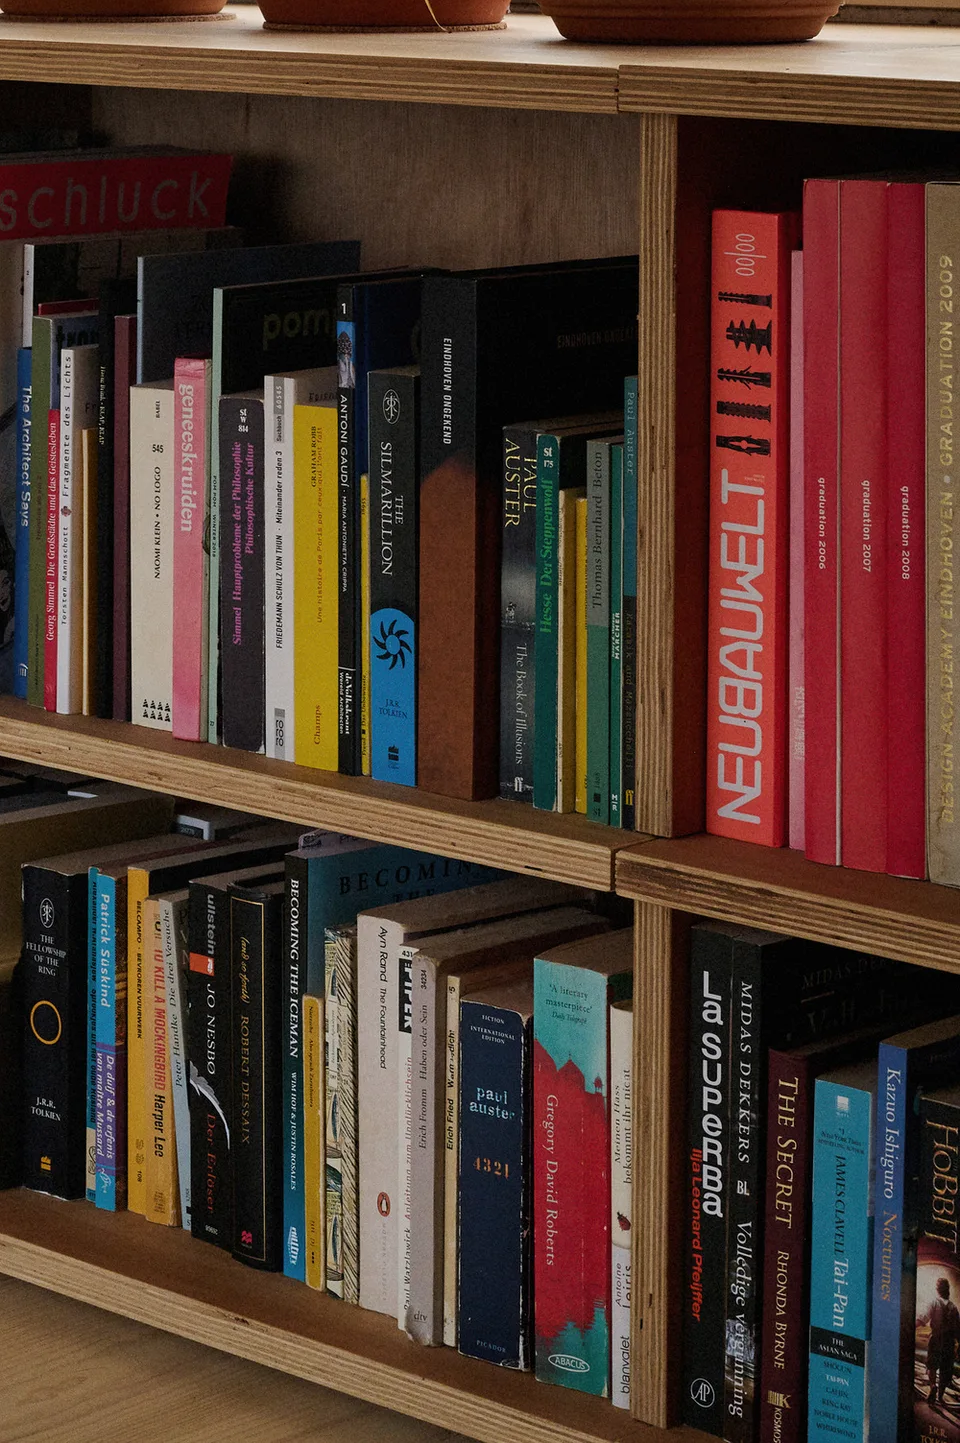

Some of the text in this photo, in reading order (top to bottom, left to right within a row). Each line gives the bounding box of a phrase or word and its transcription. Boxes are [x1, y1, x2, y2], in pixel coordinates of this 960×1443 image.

[341, 303, 346, 315] 1
[443, 338, 452, 444] EINDHOVEN ONGEKEND
[940, 255, 953, 466] GRADUATION 2009
[21, 385, 31, 526] The Architect Says
[178, 383, 198, 532] geneeskruiden
[245, 443, 255, 554] Philosophische Kultur
[505, 438, 521, 528] AUSTER
[523, 456, 537, 512] PAUL
[232, 441, 243, 645] Simmel Hauptprobleme der Philosophie
[381, 442, 393, 577] SILMARILLION
[395, 496, 404, 525] THE
[540, 478, 553, 633] Hesse Der Steppenwolf
[818, 478, 826, 570] graduation 2006
[861, 480, 871, 572] graduation 2007
[901, 486, 910, 580] graduation 2008
[717, 468, 765, 826] NEUBAUWELT
[314, 705, 322, 745] Champs
[515, 643, 527, 765] The Book of Illusions
[40, 934, 56, 944] THE
[100, 893, 112, 1007] Patrick Süskind
[205, 893, 217, 954] ullstein
[289, 879, 300, 1058] BECOMING THE ICEMAN
[205, 983, 217, 1075] JO NESBØ
[481, 1035, 505, 1045] EDITION
[482, 1015, 505, 1025] FICTION
[106, 1054, 115, 1159] De duif & de erfenis
[241, 1015, 251, 1144] ROBERT DESSAIX
[476, 1088, 510, 1105] paul
[738, 981, 753, 1164] MIDAS DEKKERS
[153, 1094, 166, 1157] Harper Lee
[205, 1113, 217, 1213] Der Erlöser
[473, 1157, 510, 1179] 4321
[881, 1067, 902, 1199] Kazuo Ishiguro
[543, 1093, 559, 1266] Gregory David Roberts
[690, 1148, 703, 1322] Ilja Leonard Pfeijffer
[881, 1210, 897, 1302] Nocturnes
[413, 1311, 429, 1322] dtv
[615, 1265, 623, 1307] Antoine
[730, 1221, 752, 1419] Volledige vergunning
[773, 1251, 790, 1370] RHONDA BYRNE
[833, 1258, 849, 1327] Tai-Pan
[476, 1339, 506, 1353] PICADOR
[553, 1356, 586, 1373] ABACUS
[620, 1336, 631, 1394] blanvalet
